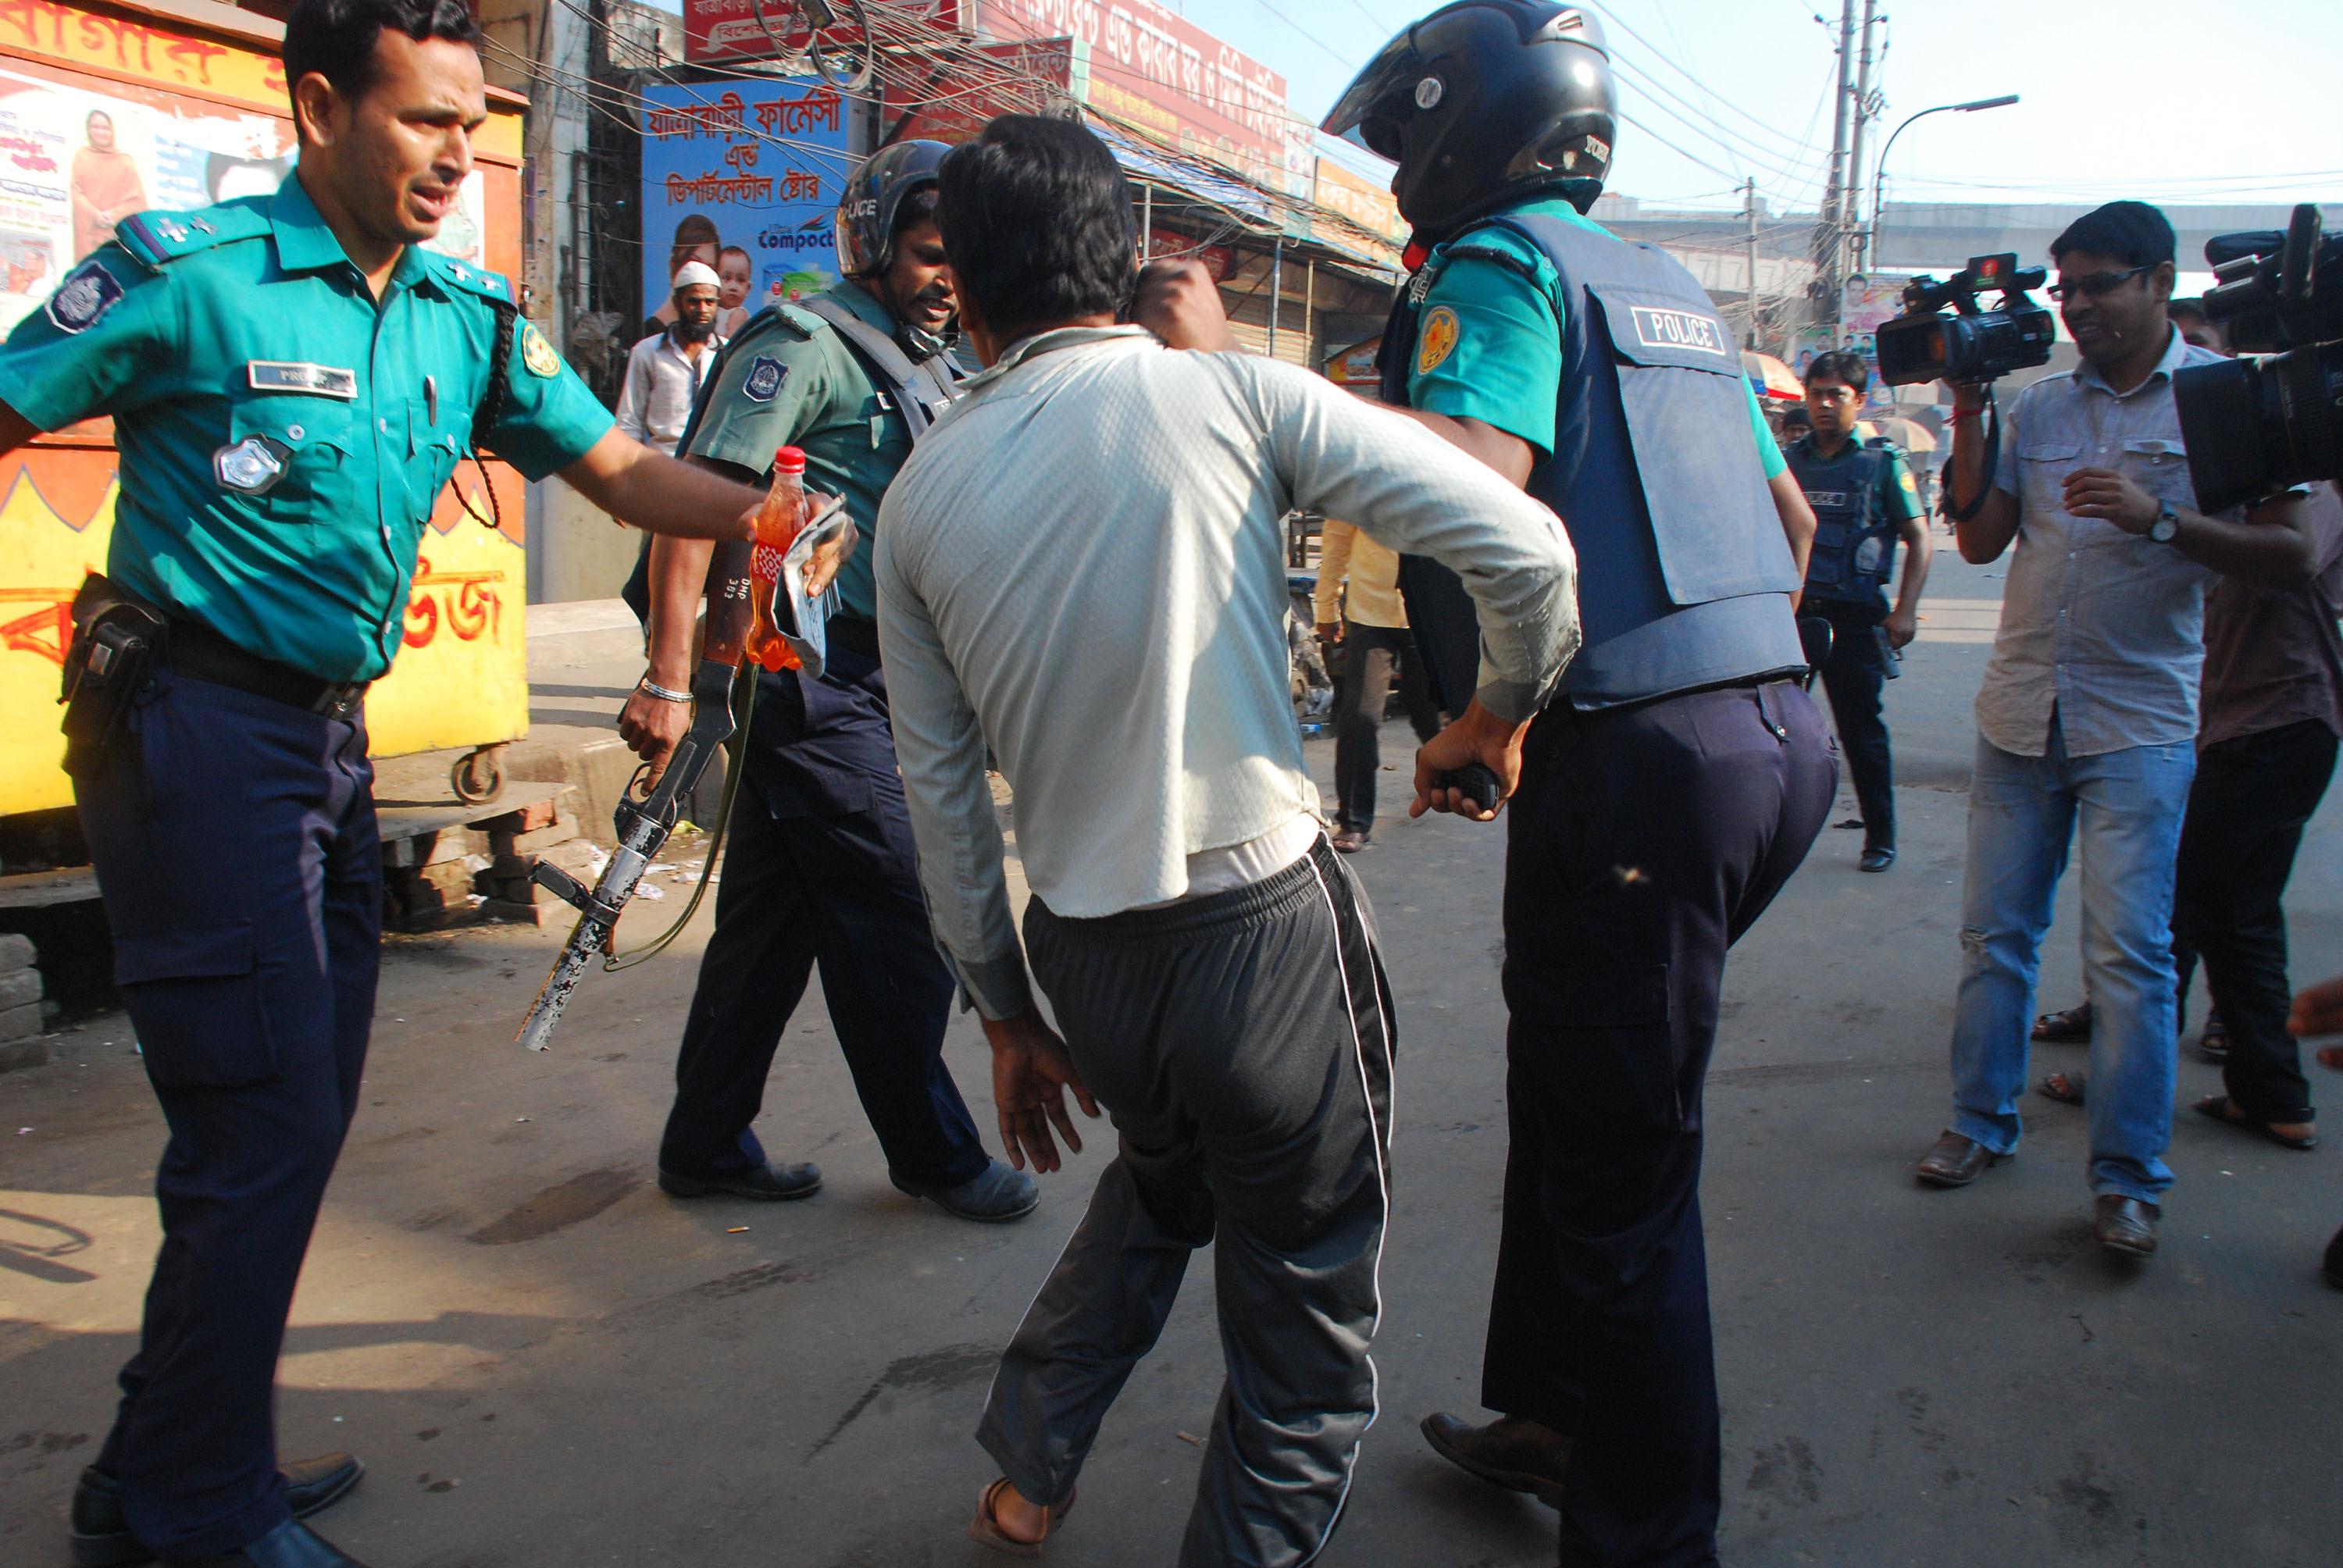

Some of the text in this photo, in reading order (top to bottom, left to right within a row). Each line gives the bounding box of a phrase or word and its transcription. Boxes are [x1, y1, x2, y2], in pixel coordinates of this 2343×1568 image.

[648, 85, 842, 143] যাত্রাবাড়ী ফার্মেসী
[842, 199, 877, 220] LICE
[1650, 313, 1713, 347] POLICE
